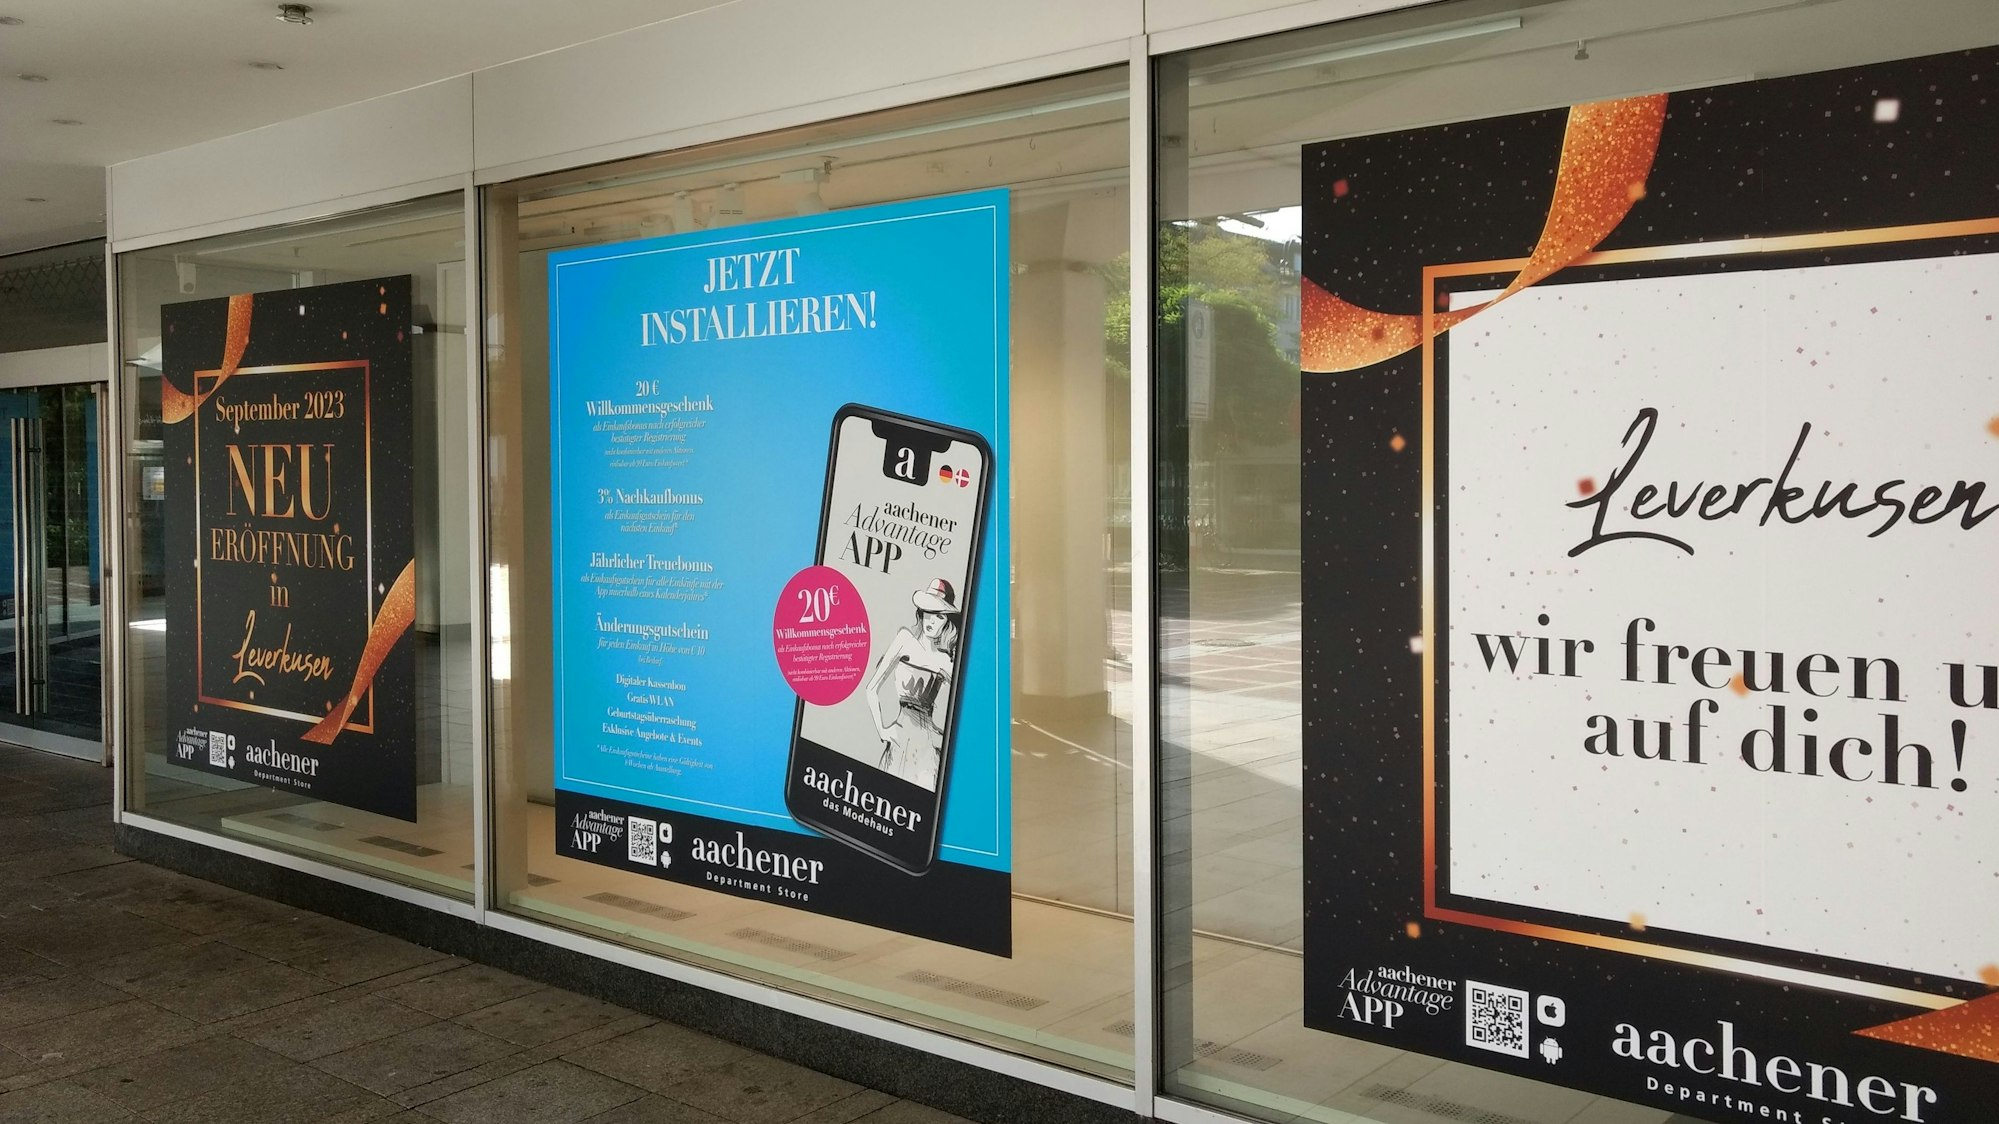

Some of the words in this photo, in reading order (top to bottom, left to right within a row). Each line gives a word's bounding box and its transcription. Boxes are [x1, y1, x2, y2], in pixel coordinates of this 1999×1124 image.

[703, 247, 800, 294] JETZT
[640, 290, 877, 346] INSTALLIEREN!
[635, 380, 650, 397] 20
[652, 379, 660, 396] €
[216, 393, 300, 427] September
[304, 390, 345, 419] 2023
[586, 394, 714, 418] Willkommensgeschenk
[894, 447, 916, 480] a
[225, 444, 335, 521] NEU
[597, 488, 613, 504] 3%
[616, 488, 704, 505] Nachkaufbonus
[1565, 407, 1999, 558] Leverkusen
[843, 502, 952, 560] Advantage
[883, 501, 957, 532] aachener
[210, 523, 355, 570] ERÖFFNUNG
[590, 552, 645, 569] Jährlicher
[645, 554, 714, 572] Treuebonus
[838, 530, 903, 574] APP
[269, 573, 290, 608] in
[595, 612, 709, 641] Änderungsgutschein
[776, 623, 867, 639] Willkommensgeschenk
[232, 609, 334, 686] Leverkusen
[1471, 613, 1595, 677] wir
[1619, 617, 1907, 702] freuen
[616, 673, 647, 687] Digitaler
[647, 677, 686, 691] Kassenbon
[627, 692, 648, 703] Gratis
[648, 695, 675, 706] WLAN
[186, 726, 208, 738] aachener
[602, 722, 635, 736] Exklusive
[635, 727, 669, 742] Angebote
[669, 733, 676, 742] &
[678, 733, 703, 747] Events
[607, 706, 697, 731] Geburtstagsüberraschung
[176, 730, 207, 750] Advantage
[176, 743, 194, 760] APP
[1583, 698, 1720, 765] auf
[1740, 704, 1968, 792] dich!
[245, 739, 319, 776] aachener
[254, 769, 291, 785] Department
[293, 779, 311, 789] Store
[803, 766, 922, 832] aachener
[570, 812, 623, 842] Advantage
[588, 809, 624, 825] aachener
[823, 797, 840, 812] das
[842, 805, 894, 837] Modehaus
[570, 831, 601, 853] APP
[691, 831, 824, 884] aachener
[706, 871, 772, 894] Department
[778, 886, 809, 902] Store
[1337, 967, 1454, 1016] Advantage
[1378, 965, 1457, 992] aachener
[1337, 991, 1404, 1029] APP
[1611, 1020, 1938, 1123] aachener
[1646, 1076, 1802, 1124] Department
